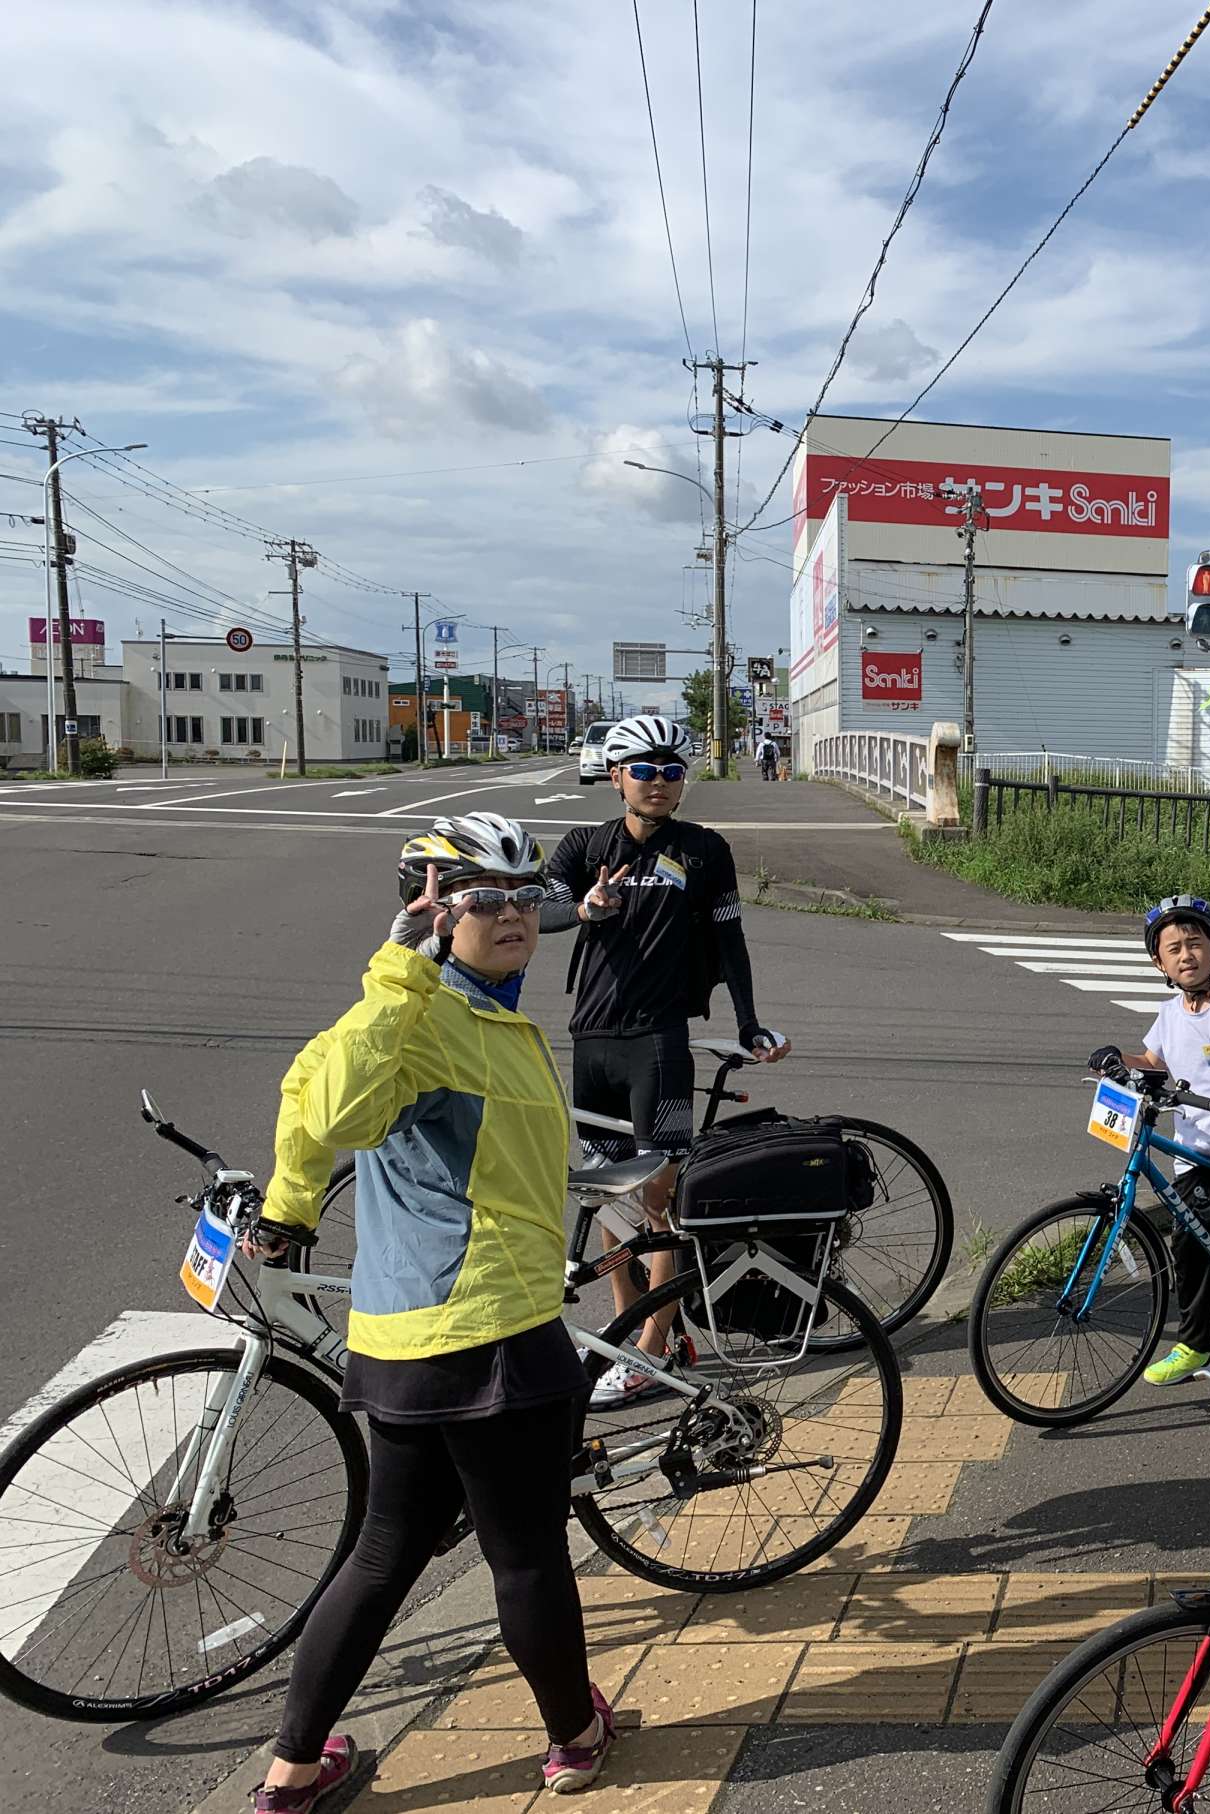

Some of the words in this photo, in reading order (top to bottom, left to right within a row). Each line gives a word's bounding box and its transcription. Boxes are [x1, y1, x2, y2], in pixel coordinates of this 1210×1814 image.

[1067, 483, 1158, 527] Sanki
[232, 634, 246, 646] 50
[864, 664, 919, 689] Sanki
[891, 702, 919, 711] サンキ
[1104, 1110, 1119, 1129] 38
